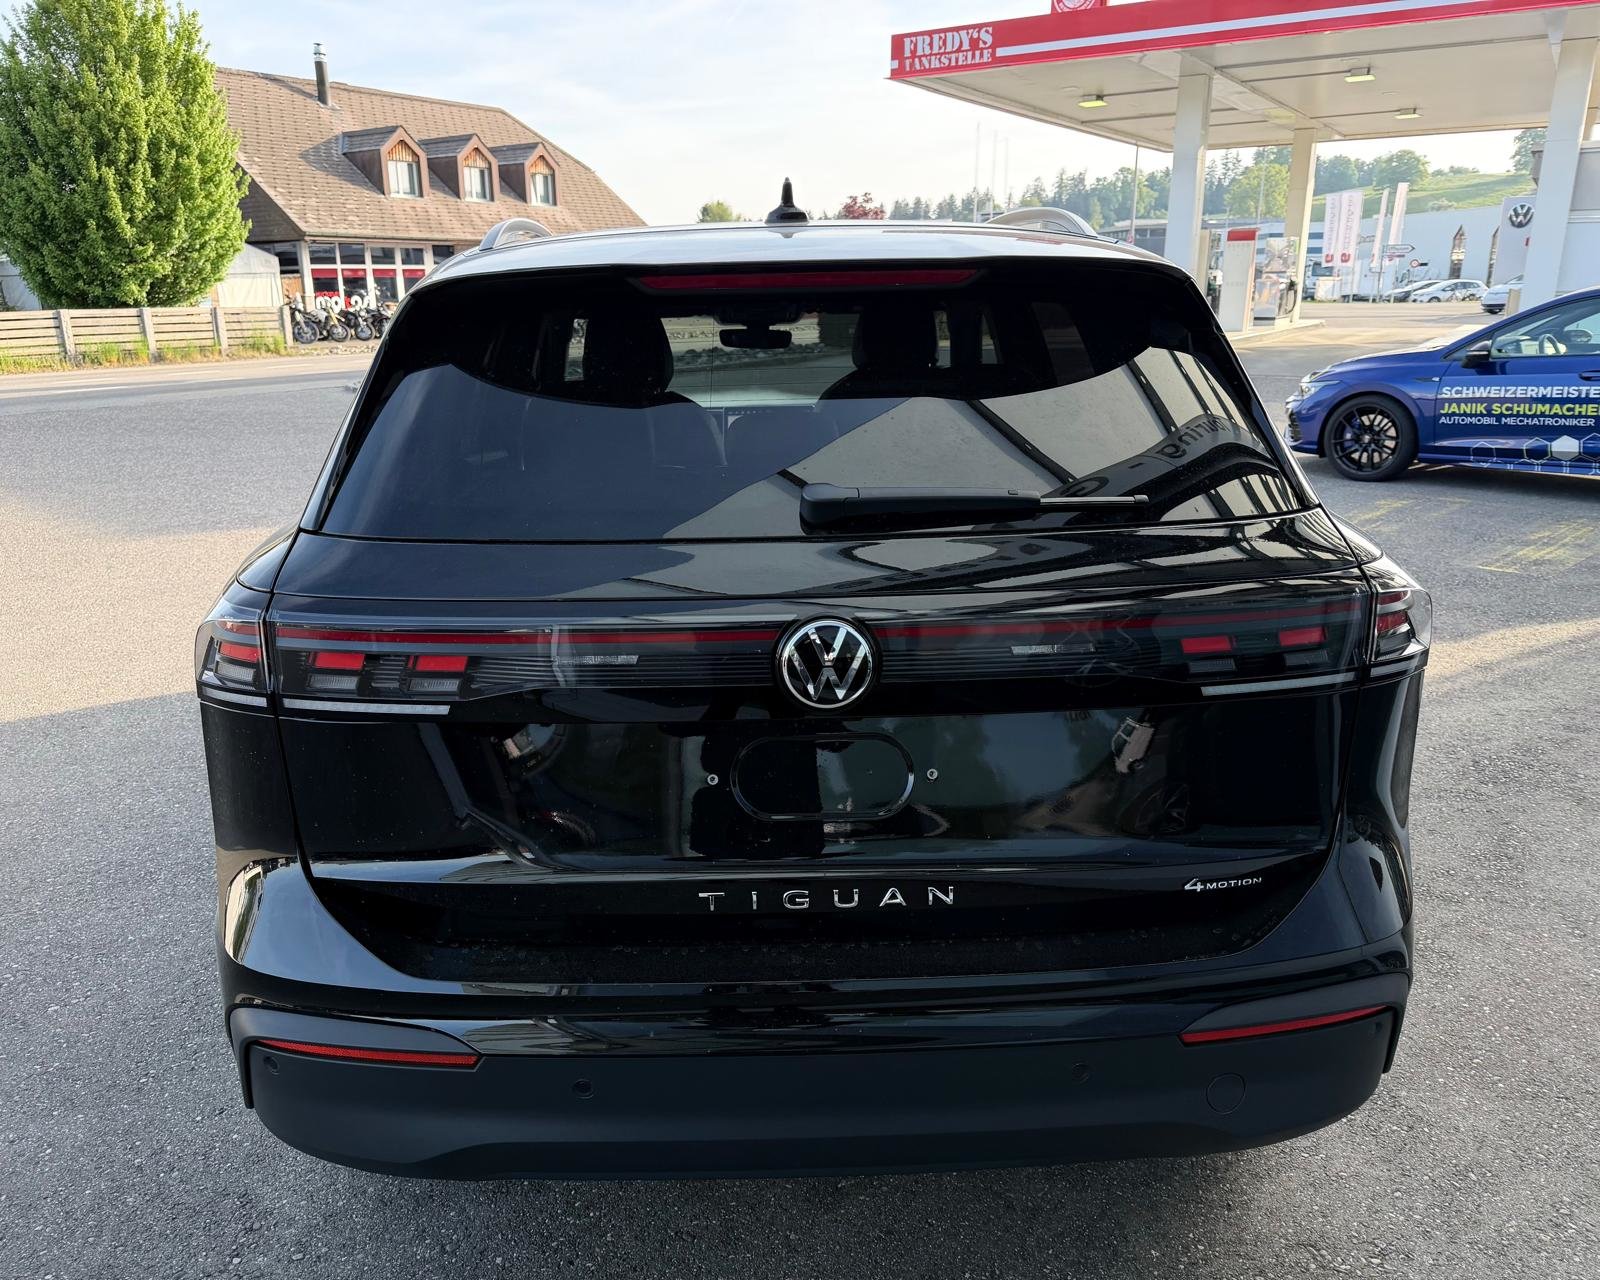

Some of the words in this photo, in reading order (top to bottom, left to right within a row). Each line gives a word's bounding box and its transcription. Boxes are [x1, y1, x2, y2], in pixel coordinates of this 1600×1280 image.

[904, 26, 993, 57] FREDY'S
[904, 49, 993, 71] TANKSTELLE
[1440, 402, 1488, 414] JANIK
[1491, 403, 1600, 416] SCHUMACHE
[1438, 416, 1499, 425] AUTOMOBIL
[1501, 416, 1595, 426] MECHATRONIKER
[1184, 877, 1262, 892] 4MOTION
[698, 886, 954, 911] TIGUAN
